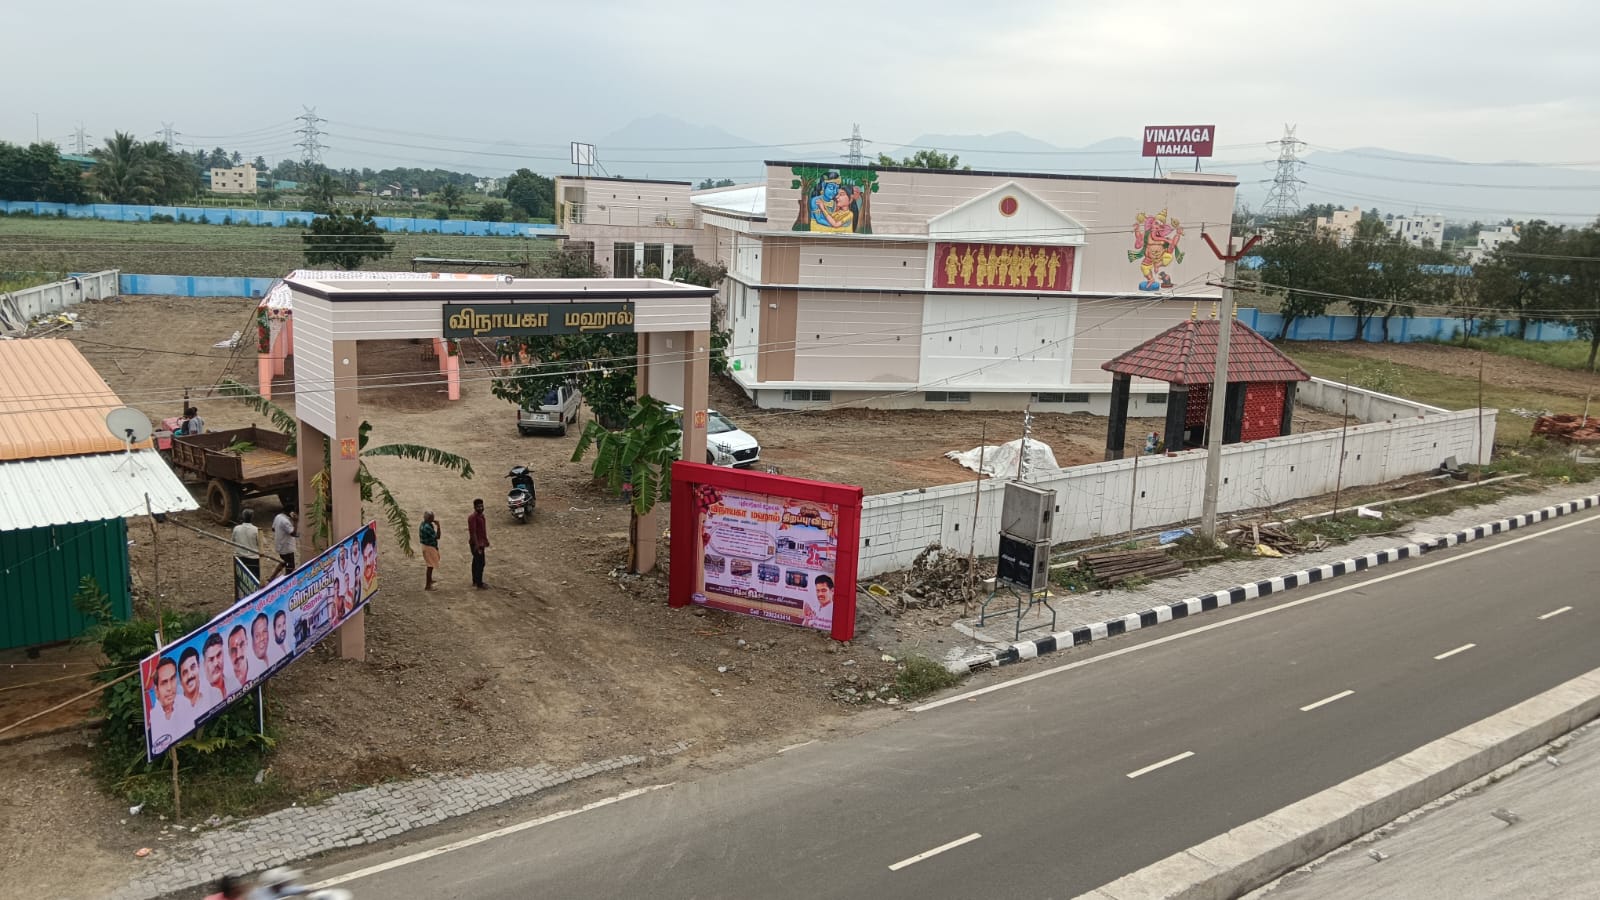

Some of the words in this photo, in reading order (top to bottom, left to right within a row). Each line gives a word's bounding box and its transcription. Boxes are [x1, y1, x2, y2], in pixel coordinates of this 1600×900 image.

[1146, 128, 1210, 143] VINAYAGA
[1156, 145, 1195, 154] MAHAL
[449, 307, 549, 336] விநாயகா
[564, 304, 633, 332] மஹால்
